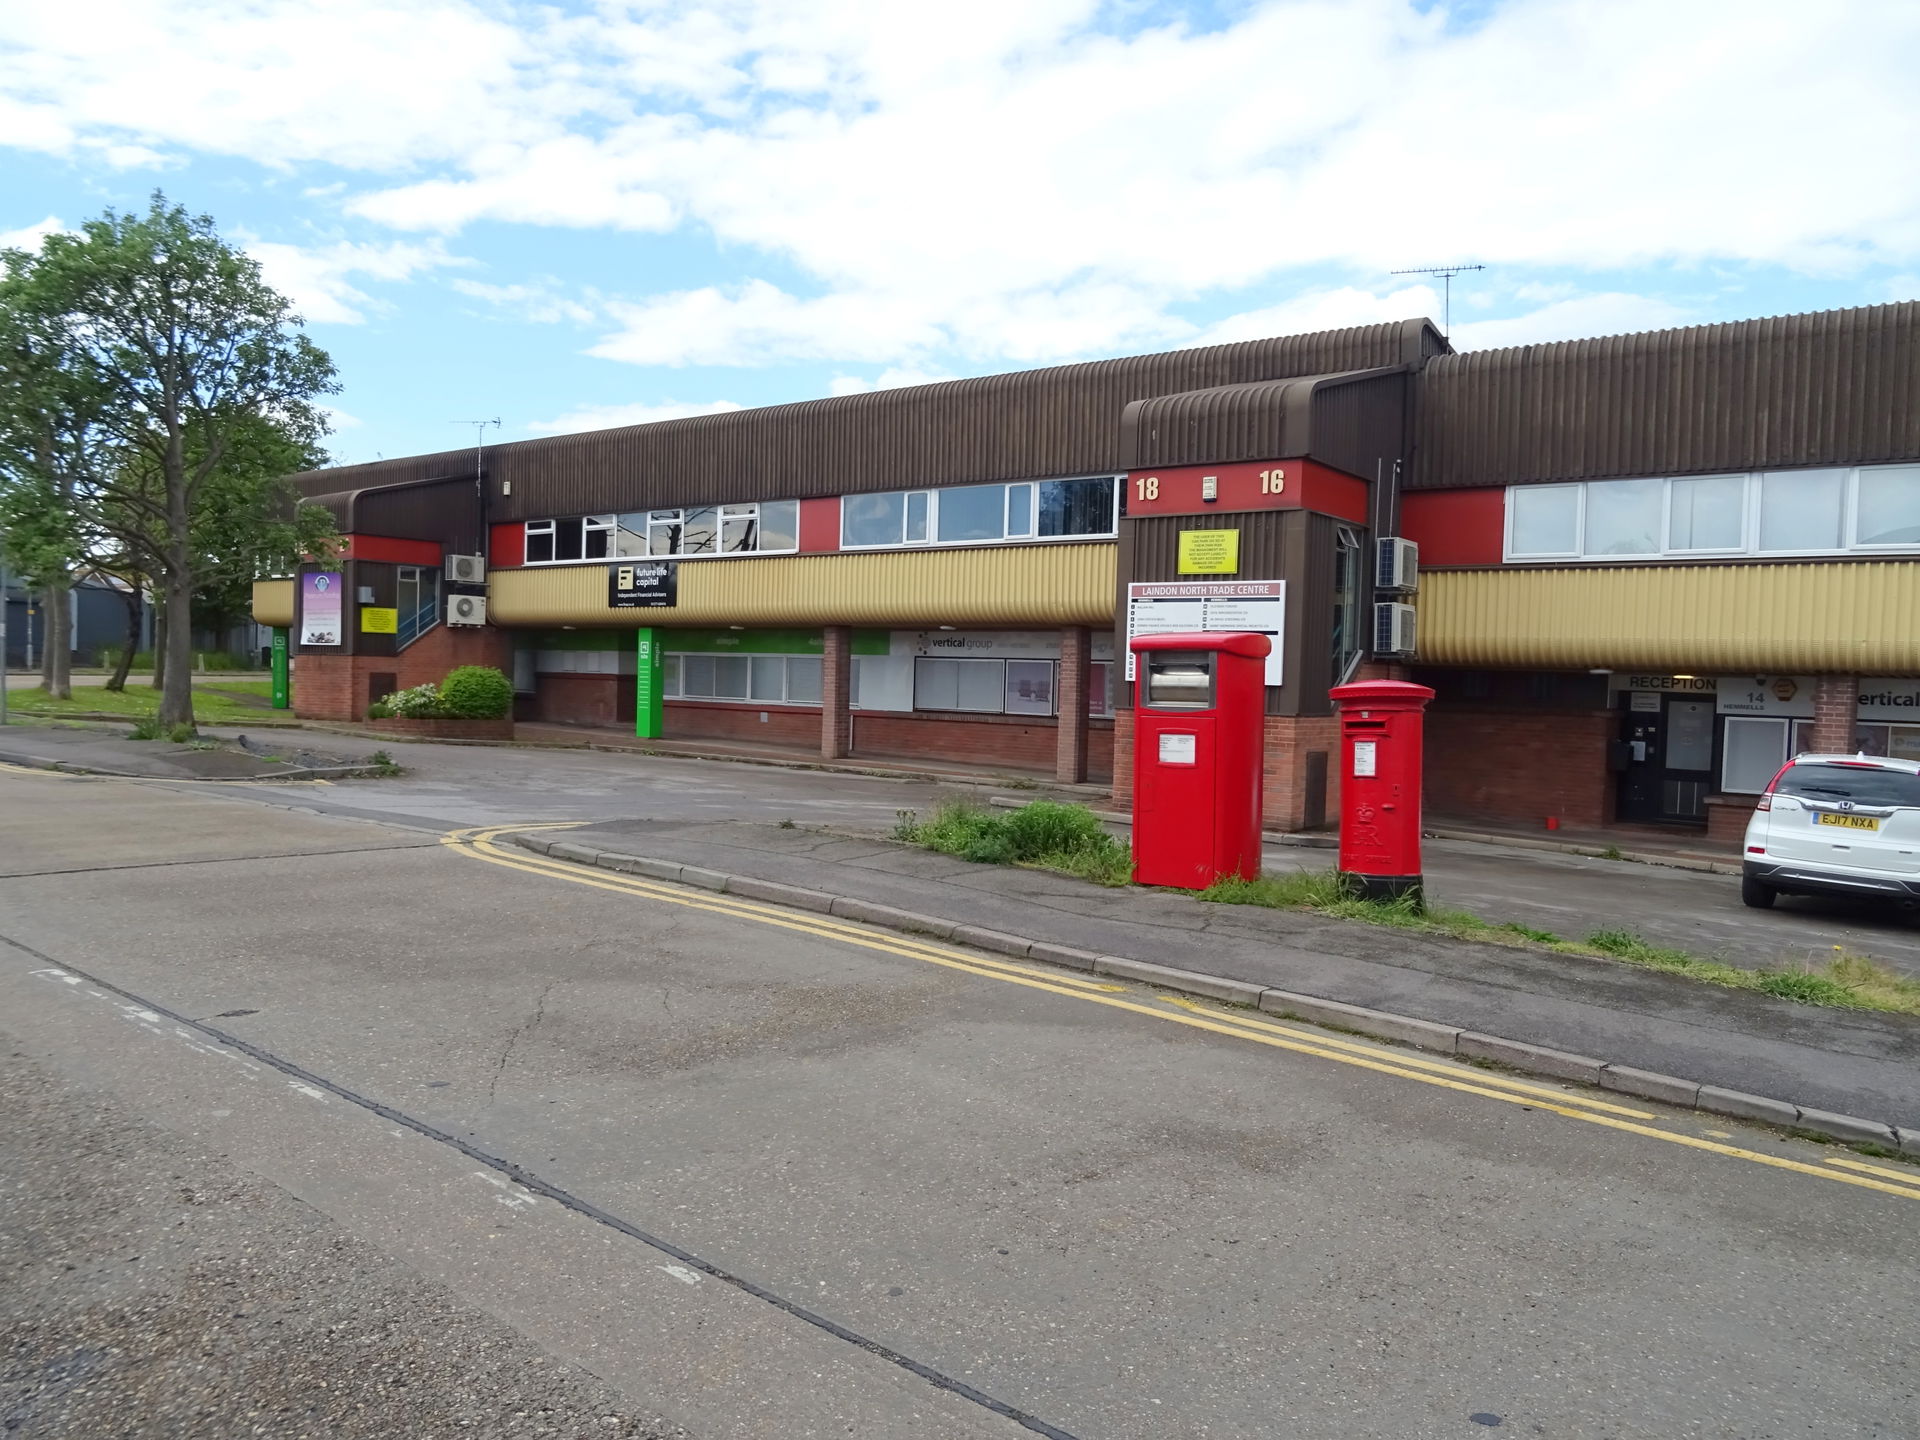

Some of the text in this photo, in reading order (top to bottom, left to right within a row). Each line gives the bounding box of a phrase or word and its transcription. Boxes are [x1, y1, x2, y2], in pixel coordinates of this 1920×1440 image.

[1260, 469, 1284, 494] 16
[1136, 477, 1159, 500] 18
[636, 568, 656, 576] future
[656, 567, 667, 576] life
[636, 577, 659, 588] capital
[1142, 585, 1269, 595] LAINDON NORTH TRADE CENTRE
[932, 637, 965, 648] vertical
[966, 638, 993, 650] group
[1629, 676, 1717, 690] RECEPTION
[1746, 692, 1765, 703] 14
[1857, 691, 1920, 707] ertical
[1723, 703, 1765, 711] HEMMELLS
[1822, 814, 1874, 829] EJ17 NXA
